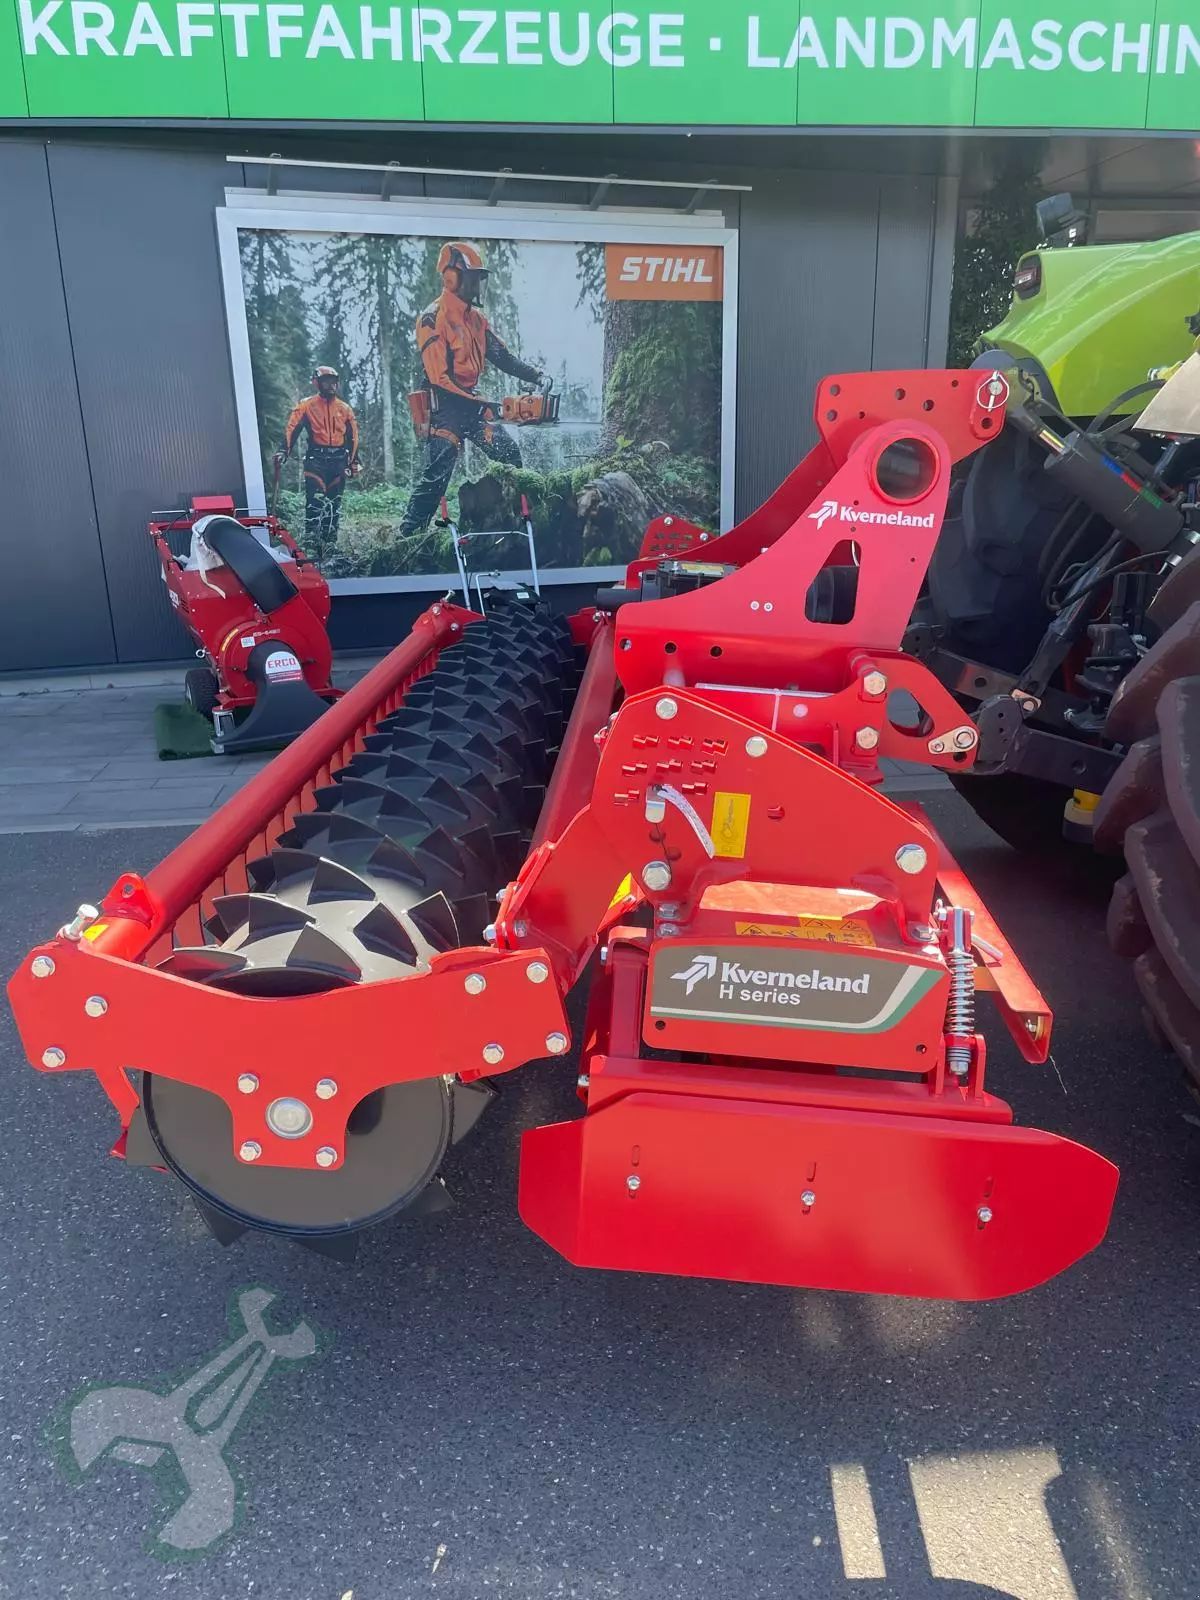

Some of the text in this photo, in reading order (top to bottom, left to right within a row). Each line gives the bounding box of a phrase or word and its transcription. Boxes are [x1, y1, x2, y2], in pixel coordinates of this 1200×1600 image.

[18, 0, 685, 67] KRAFTFAHRZEUGE
[619, 256, 713, 283] STIHL
[839, 505, 935, 528] Kverneland
[267, 657, 297, 669] ERCO
[720, 961, 871, 994] Kverneland
[719, 984, 801, 1006] H series
